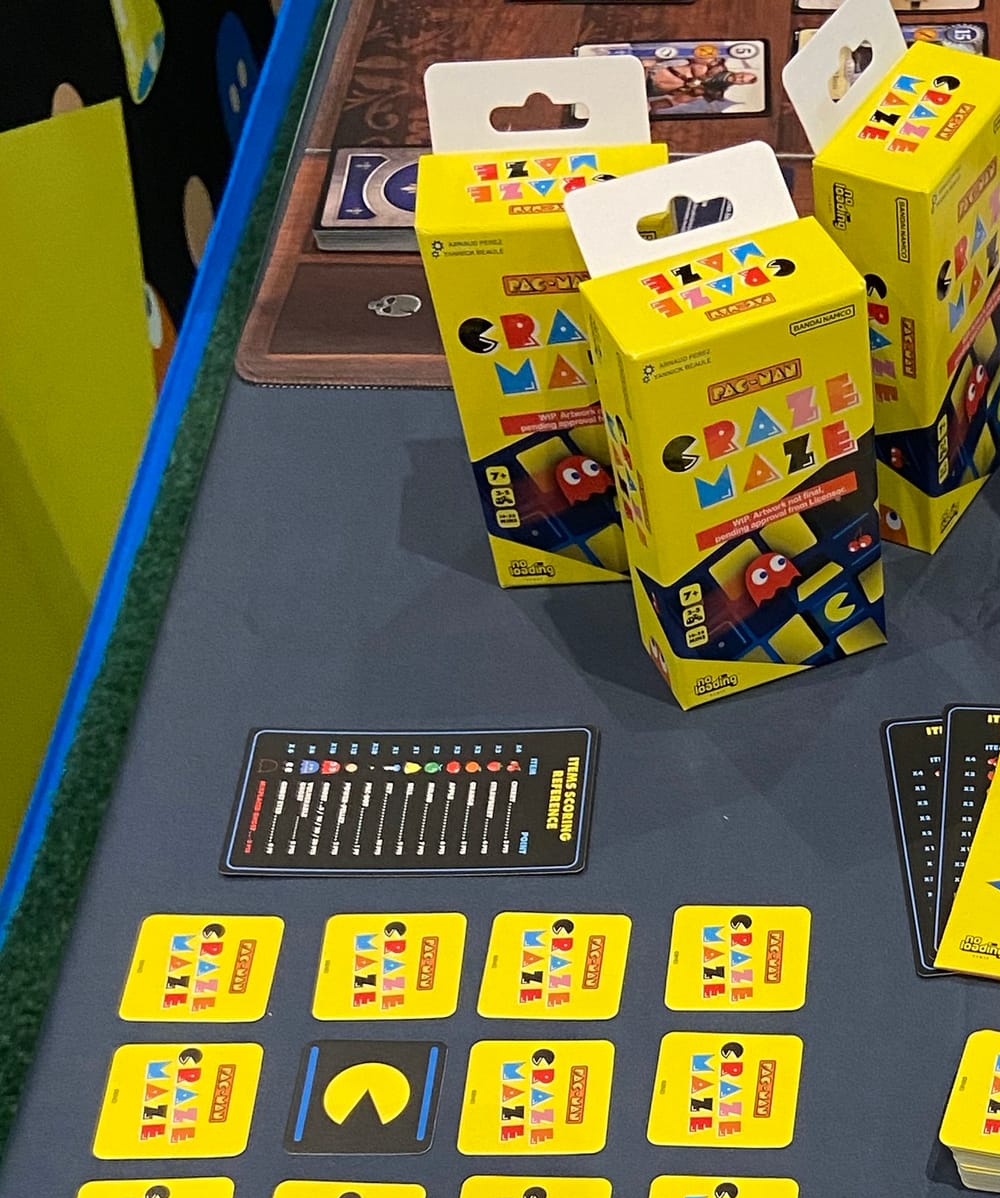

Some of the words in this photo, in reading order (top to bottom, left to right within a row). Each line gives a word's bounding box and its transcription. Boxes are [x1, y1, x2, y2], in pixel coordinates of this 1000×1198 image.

[858, 75, 925, 140] MAZE
[887, 75, 961, 153] CRAZE
[936, 103, 976, 141] PAC-MAN
[474, 155, 598, 181] MAZE
[641, 242, 766, 295] MAZE
[651, 259, 796, 318] CRAZE
[793, 316, 823, 332] BANDAI
[822, 309, 852, 324] NAMCO
[710, 361, 799, 403] PAC-MAN
[662, 372, 860, 473] CRAZE
[490, 472, 507, 480] 7+
[694, 419, 859, 510] MAZE
[715, 524, 749, 543] pending
[750, 508, 787, 529] approval
[788, 501, 808, 514] from
[754, 502, 786, 519] Artwork
[788, 495, 802, 505] not
[509, 561, 555, 577] loading
[683, 590, 699, 600] 7+
[695, 674, 739, 695] loading
[565, 757, 580, 789] ITEMS
[546, 770, 564, 829] REFERENCE
[560, 791, 576, 841] SCORING
[964, 934, 982, 945] no
[162, 934, 197, 1010] MAZE
[191, 923, 226, 1012] CRAZE
[230, 940, 256, 992] PAC-MAN
